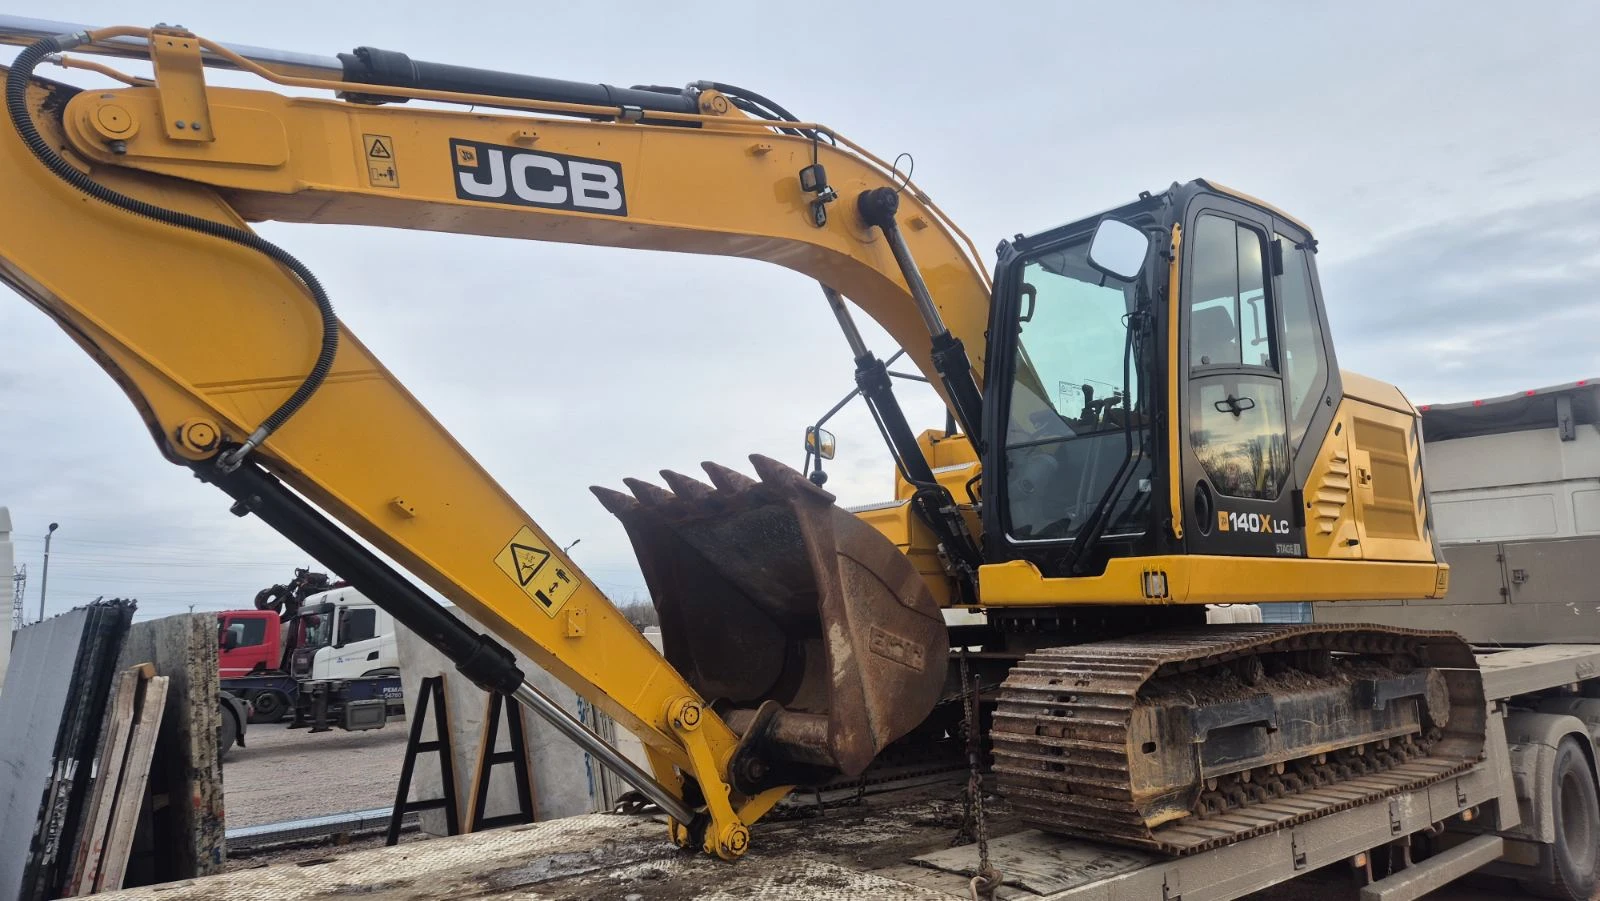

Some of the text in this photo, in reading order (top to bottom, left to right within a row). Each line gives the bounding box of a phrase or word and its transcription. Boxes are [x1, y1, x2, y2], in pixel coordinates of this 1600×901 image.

[459, 149, 622, 210] JCB
[1229, 512, 1272, 533] 140X
[1273, 520, 1290, 534] LC
[1276, 543, 1294, 554] STAGE
